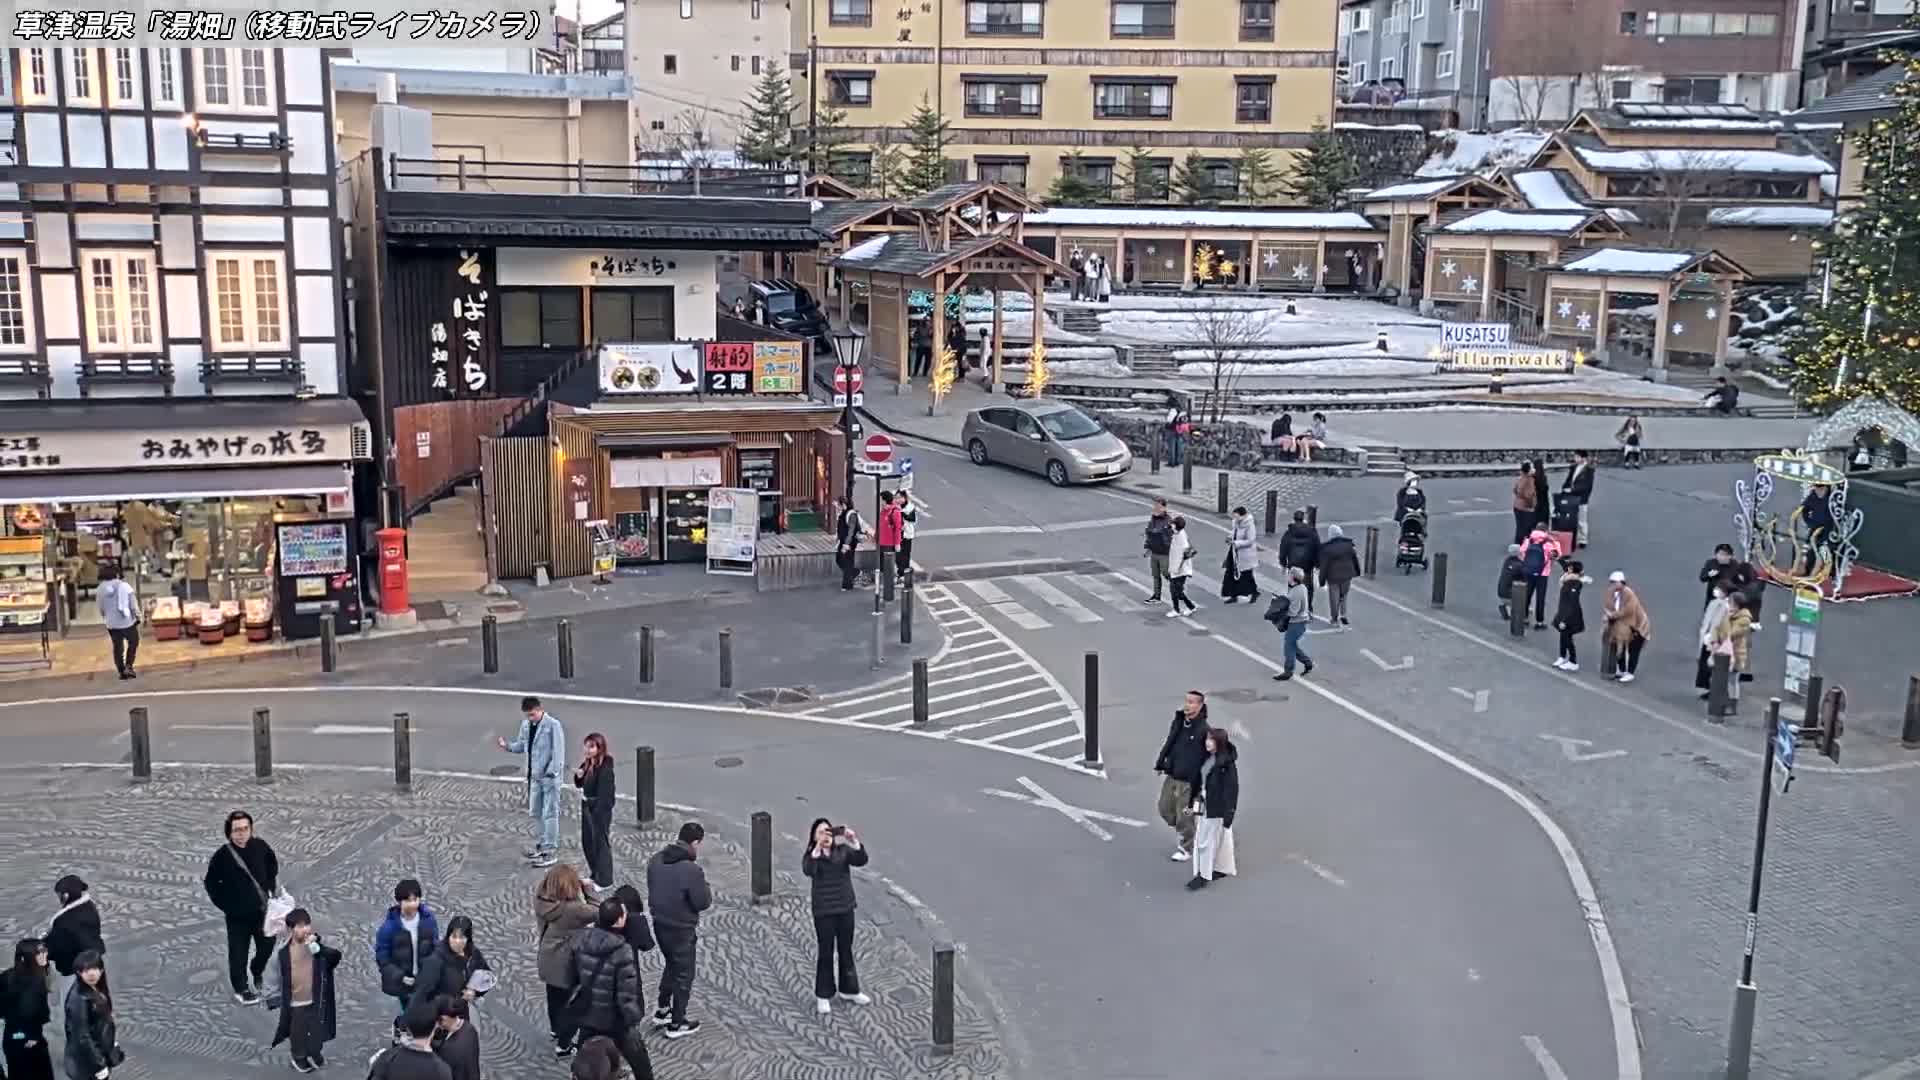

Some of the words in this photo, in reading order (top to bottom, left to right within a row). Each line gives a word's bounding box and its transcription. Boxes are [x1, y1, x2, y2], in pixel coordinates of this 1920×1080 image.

[452, 249, 489, 391] そばきち
[1445, 326, 1507, 343] KUSATSU
[709, 346, 750, 370] 射的
[1455, 352, 1564, 366] illumiwalk
[142, 429, 327, 460] おみやげの本多
